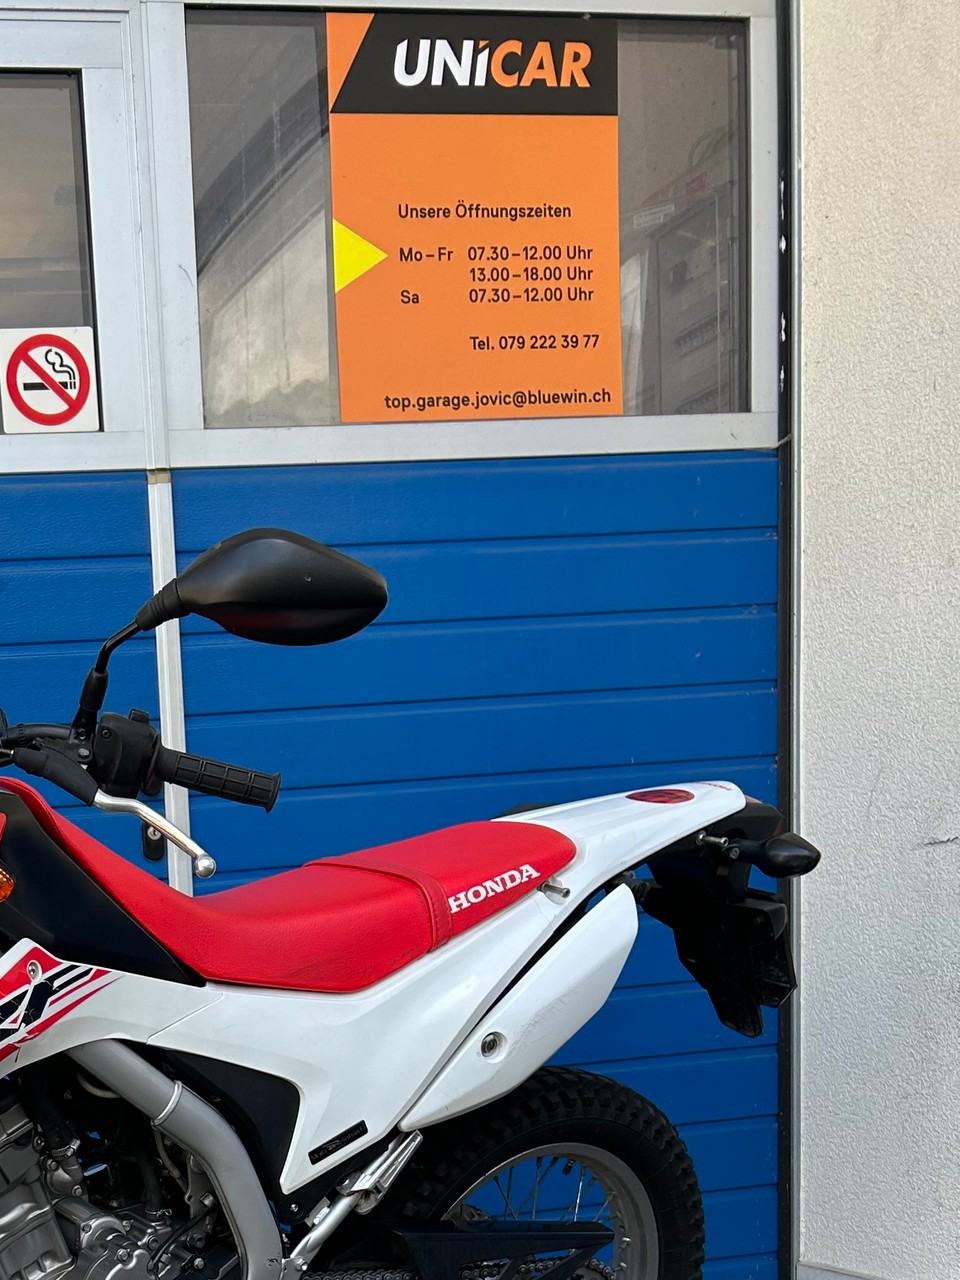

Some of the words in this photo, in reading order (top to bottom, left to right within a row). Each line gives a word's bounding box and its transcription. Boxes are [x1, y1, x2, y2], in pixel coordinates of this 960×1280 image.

[397, 203, 451, 219] Unsere
[455, 199, 572, 221] Öffnungszeiten
[566, 245, 593, 260] Uhr
[566, 266, 594, 281] Uhr
[400, 289, 420, 305] Sa
[567, 287, 594, 301] Uhr
[469, 336, 495, 350] Tel.
[498, 335, 526, 350] 079
[529, 335, 557, 349] 222
[561, 334, 579, 349] 39
[583, 334, 600, 348] 77
[384, 388, 611, 412] top.garage.jovic@bluewin.ch
[448, 863, 540, 914] HONDA
